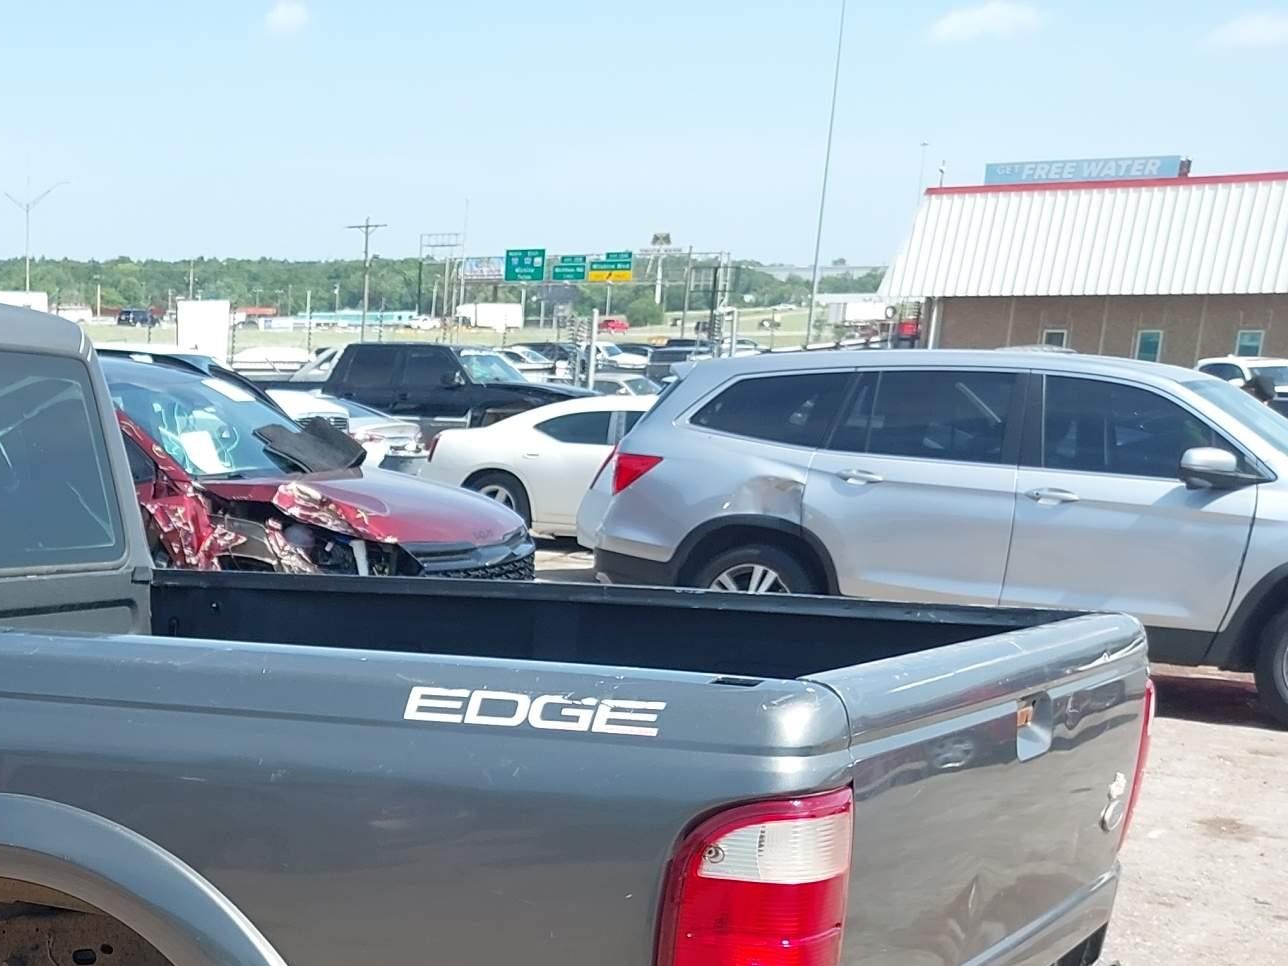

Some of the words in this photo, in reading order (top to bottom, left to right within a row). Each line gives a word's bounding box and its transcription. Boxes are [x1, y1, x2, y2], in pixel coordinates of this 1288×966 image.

[996, 165, 1018, 176] GET
[1021, 162, 1077, 180] FREE
[1082, 158, 1161, 178] WATER
[403, 686, 667, 736] EDGE
